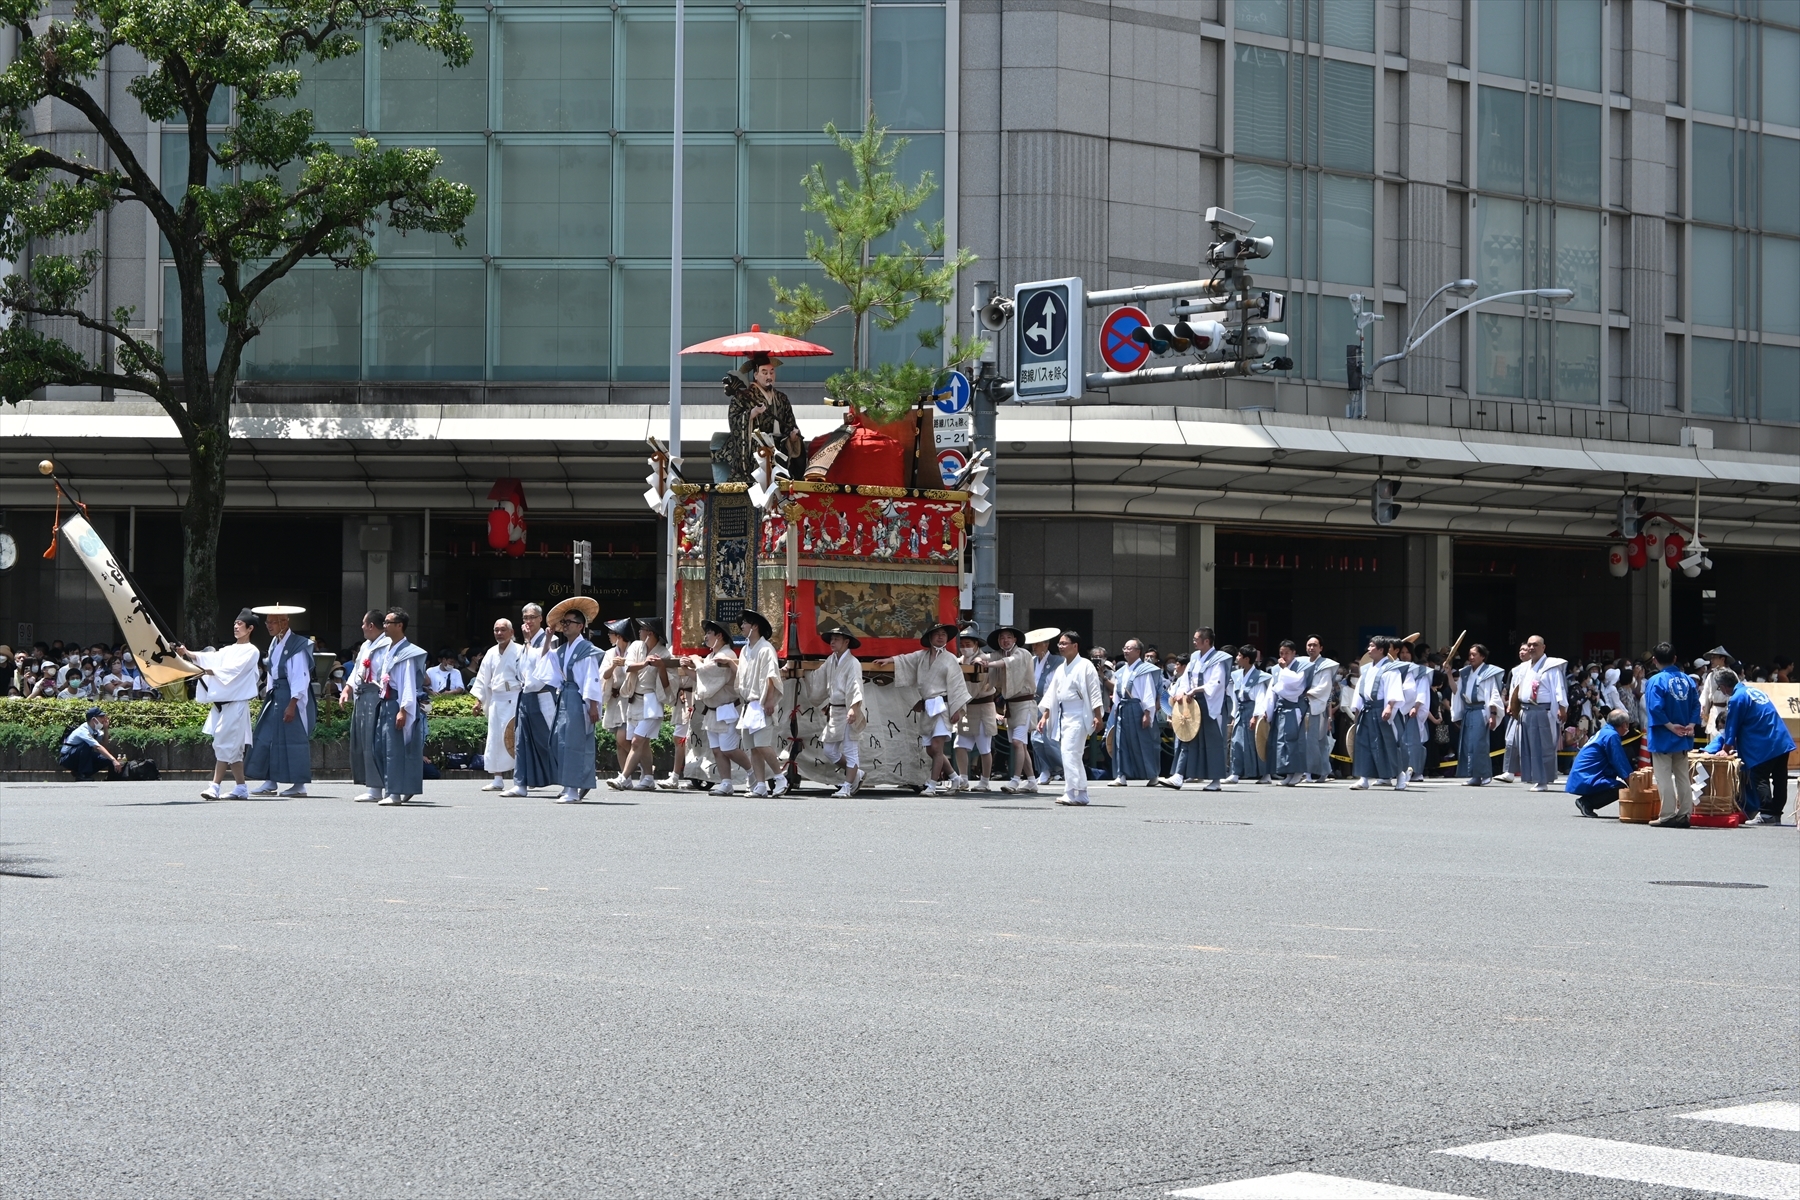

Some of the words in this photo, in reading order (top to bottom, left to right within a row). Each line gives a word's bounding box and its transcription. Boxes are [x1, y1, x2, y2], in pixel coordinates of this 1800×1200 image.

[1021, 366, 1067, 383] 路線バスを除く
[934, 417, 968, 428] 路線バスを除く
[563, 584, 629, 597] Taashimaya
